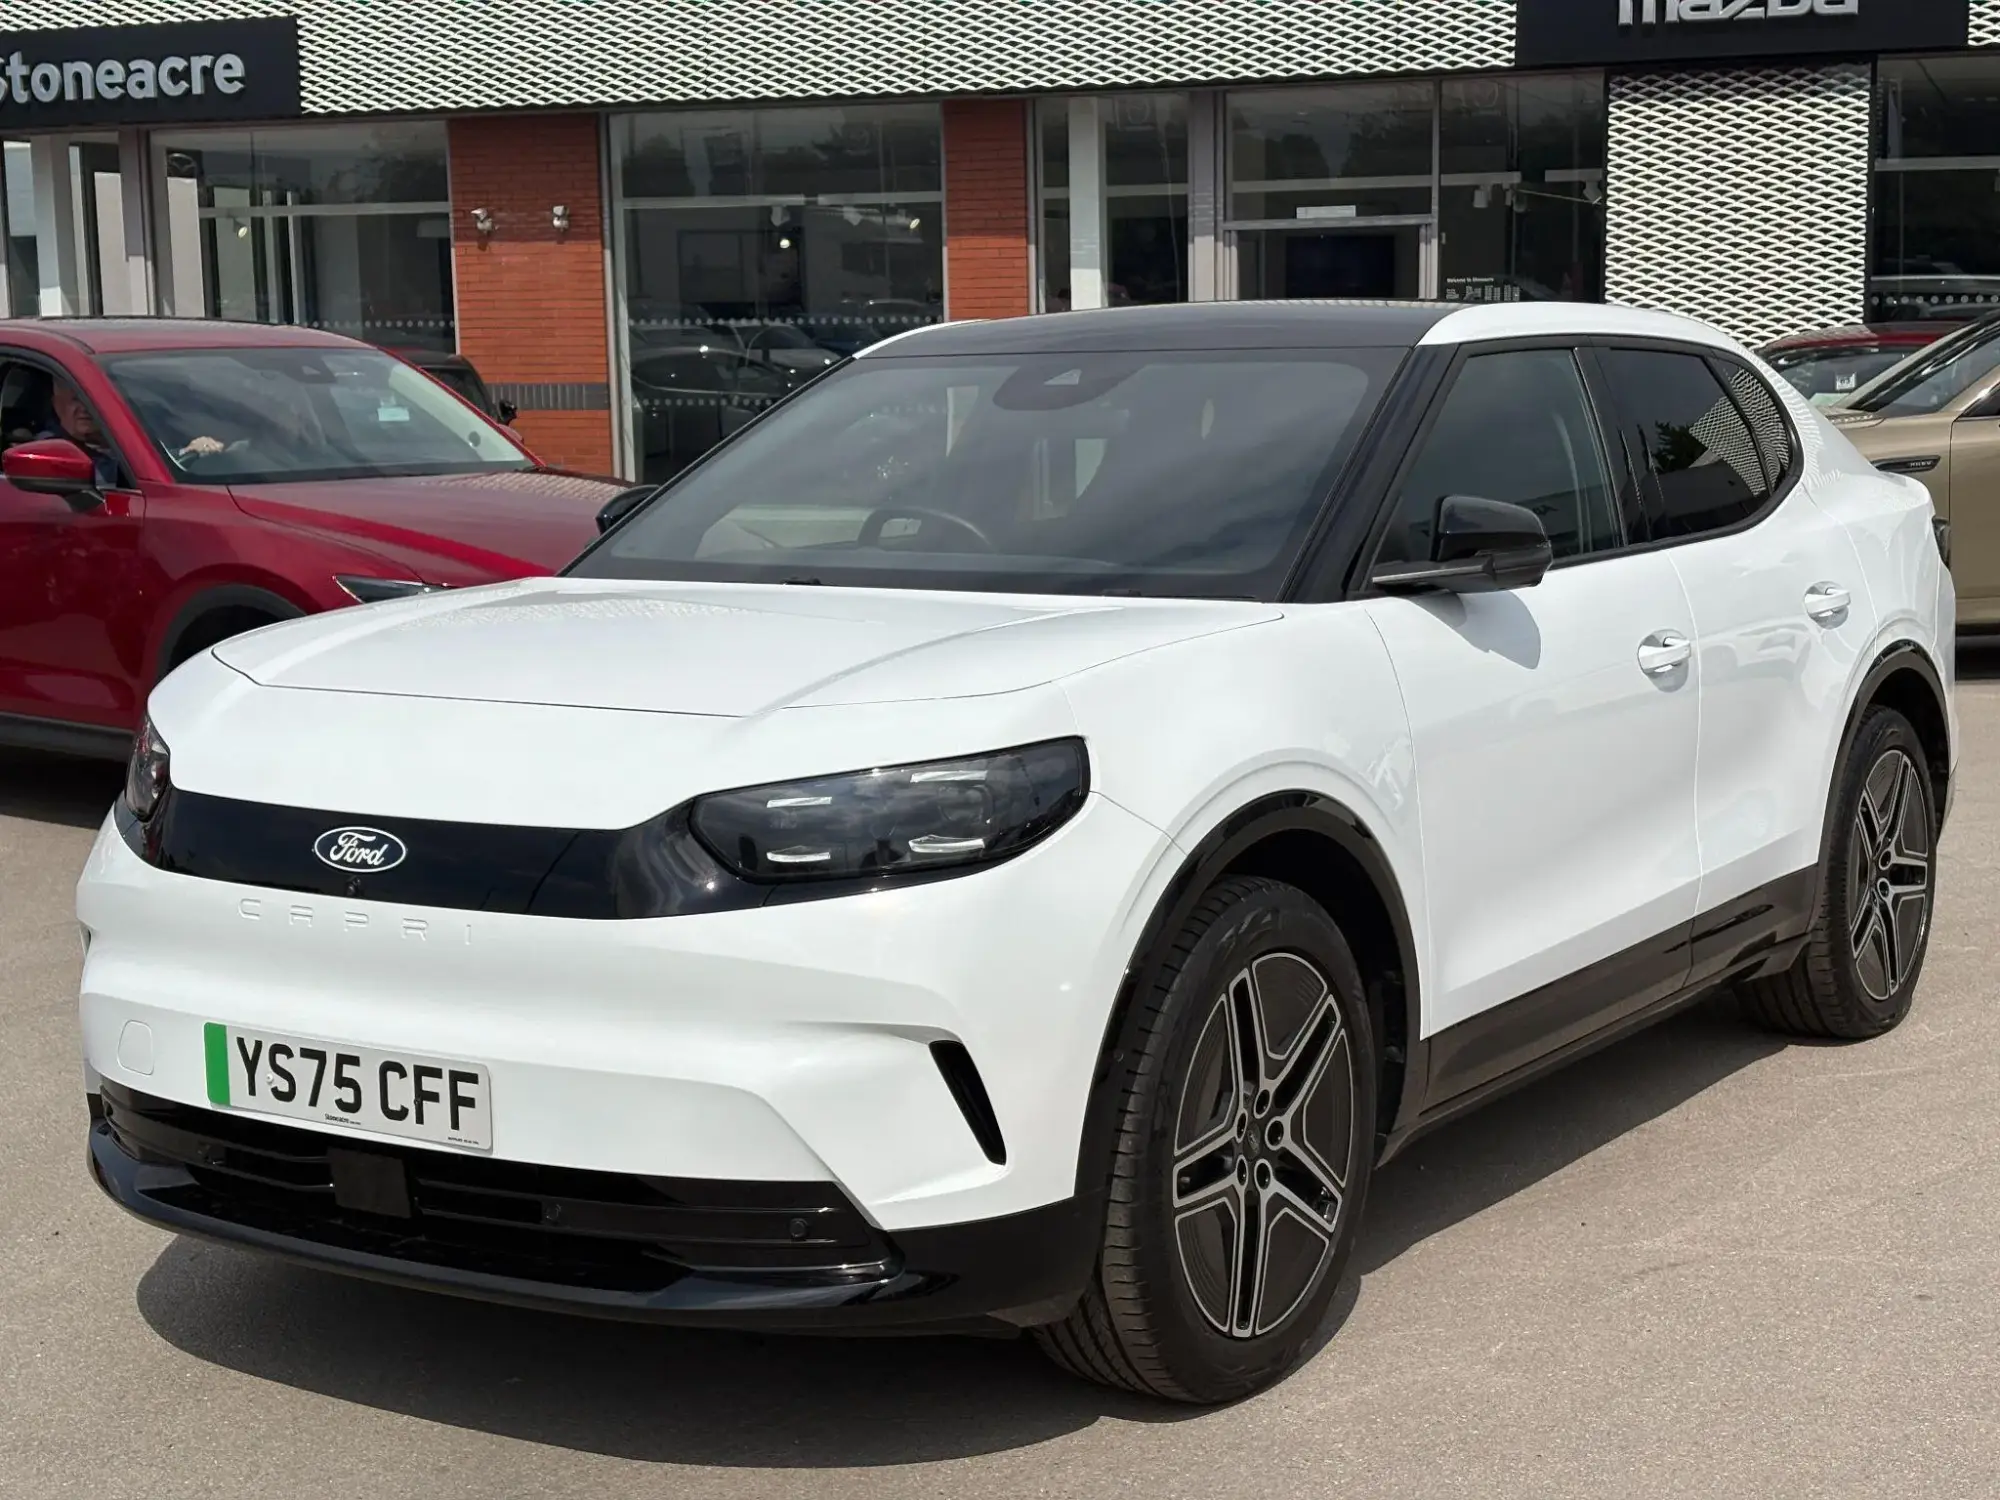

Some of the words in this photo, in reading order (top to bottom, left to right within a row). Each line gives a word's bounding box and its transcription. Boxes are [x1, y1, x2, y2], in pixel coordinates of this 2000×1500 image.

[329, 831, 389, 866] Ford
[238, 898, 471, 945] CAPRI
[236, 1036, 362, 1114] YS75
[379, 1060, 479, 1130] CFF
